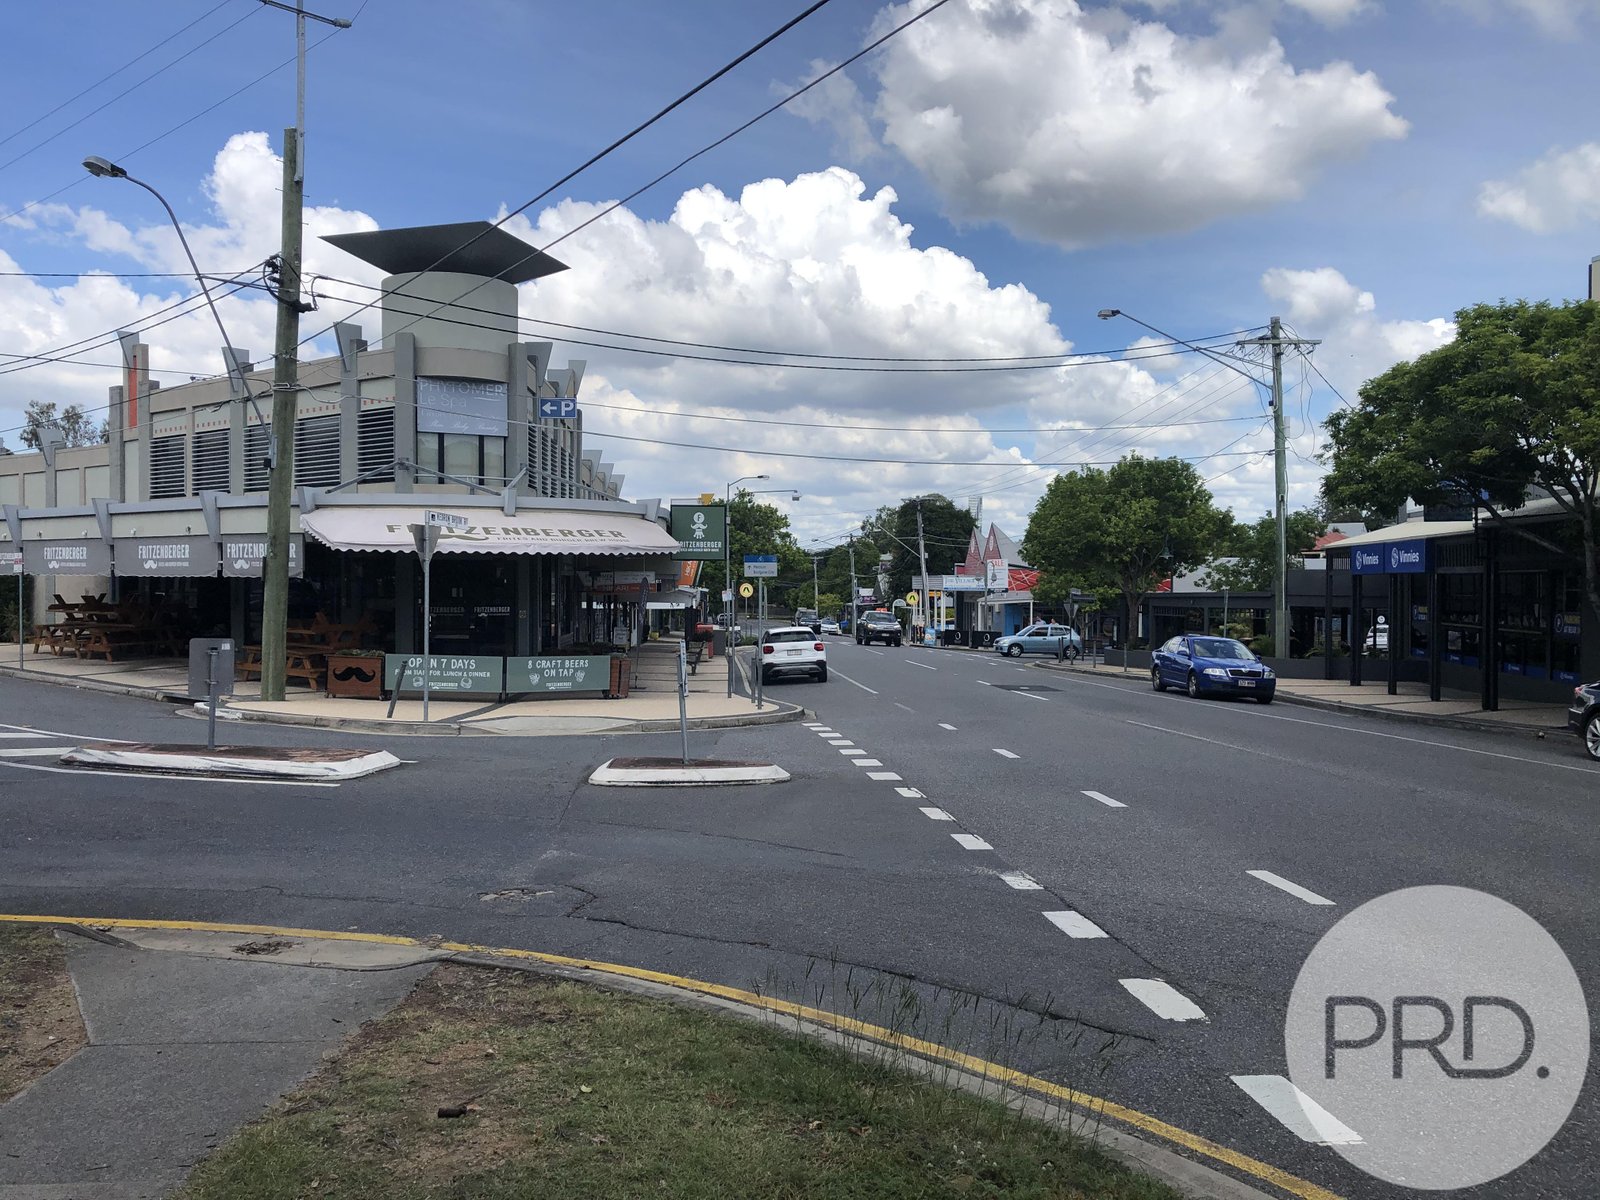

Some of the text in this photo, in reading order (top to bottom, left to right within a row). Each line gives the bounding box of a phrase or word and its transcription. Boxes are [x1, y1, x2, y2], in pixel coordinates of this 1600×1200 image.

[419, 379, 505, 397] PHYTOMER
[419, 394, 467, 410] Le Spa
[560, 400, 575, 417] P
[138, 544, 190, 559] FRITZENBERGER
[679, 540, 722, 549] RITZENBERGER
[43, 546, 88, 560] FRITZENBERGER
[1362, 552, 1379, 566] Vinnies
[1399, 549, 1420, 563] Vinnies
[408, 658, 476, 670] OPN 7 DAYS
[527, 659, 589, 669] 8 CRAFT BEERS
[543, 668, 574, 678] ON TAP
